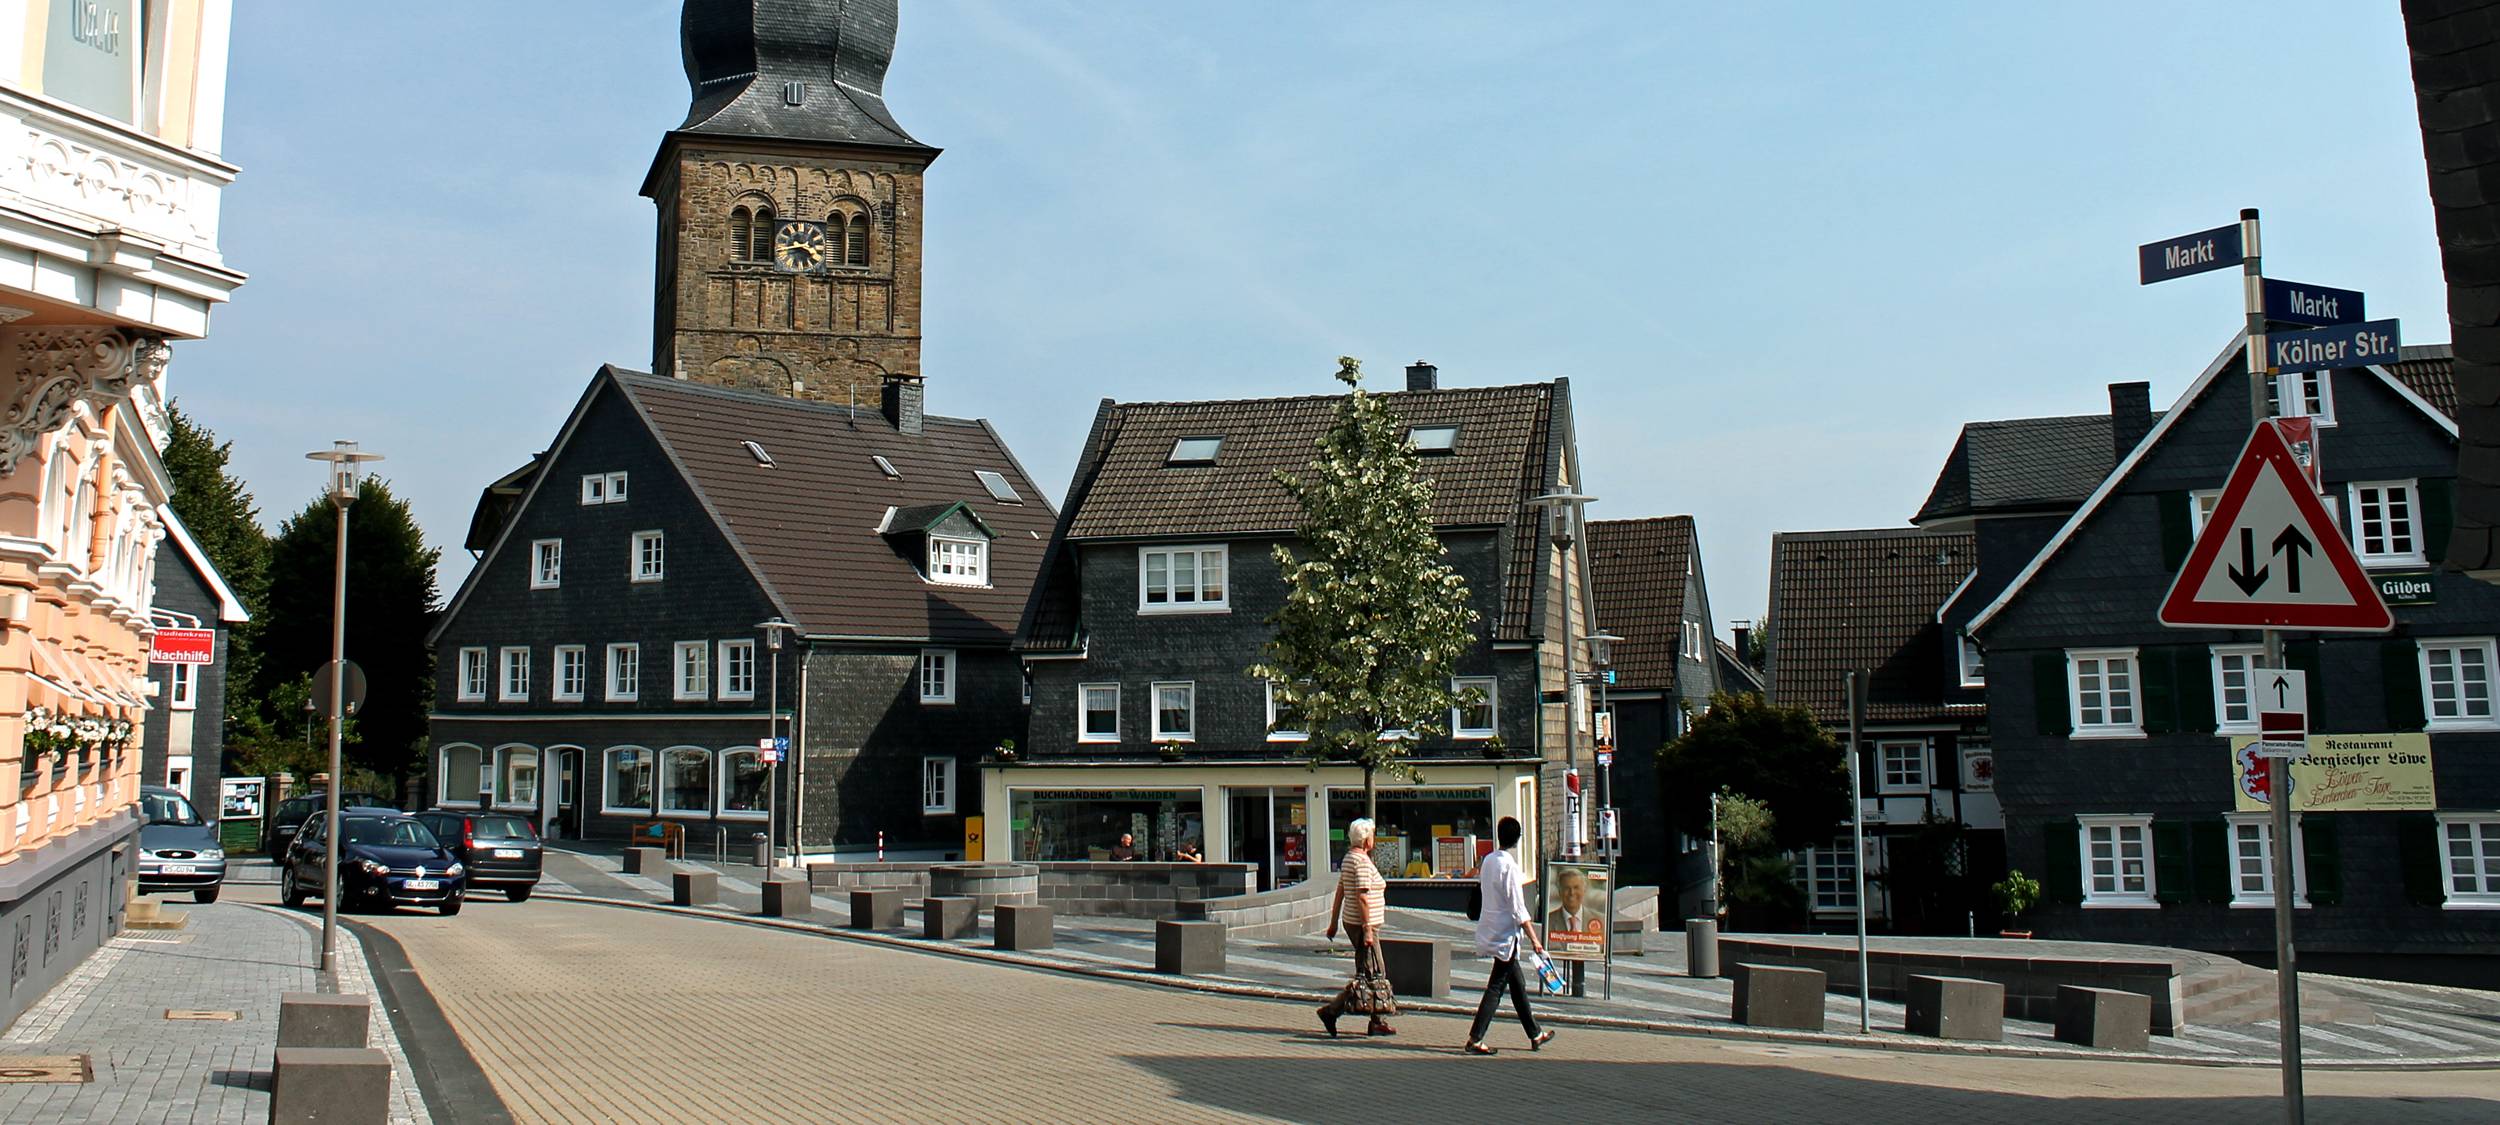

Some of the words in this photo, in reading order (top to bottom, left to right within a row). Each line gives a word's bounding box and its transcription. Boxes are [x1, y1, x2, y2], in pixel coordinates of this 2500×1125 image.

[2165, 239, 2214, 270] Markt
[2290, 290, 2339, 319] Markt
[2277, 339, 2347, 366] Kölner
[2355, 331, 2394, 358] Str.
[2382, 580, 2431, 595] Gilden
[153, 649, 210, 662] Nachhilfe
[2325, 739, 2393, 750] Restaurant
[2299, 753, 2380, 769] Bergischer
[2388, 752, 2428, 766] Löwe
[1033, 790, 1112, 800] BUCHHANDLUNG
[1128, 790, 1177, 800] WAHDEN
[1437, 789, 1487, 799] WAHDEN
